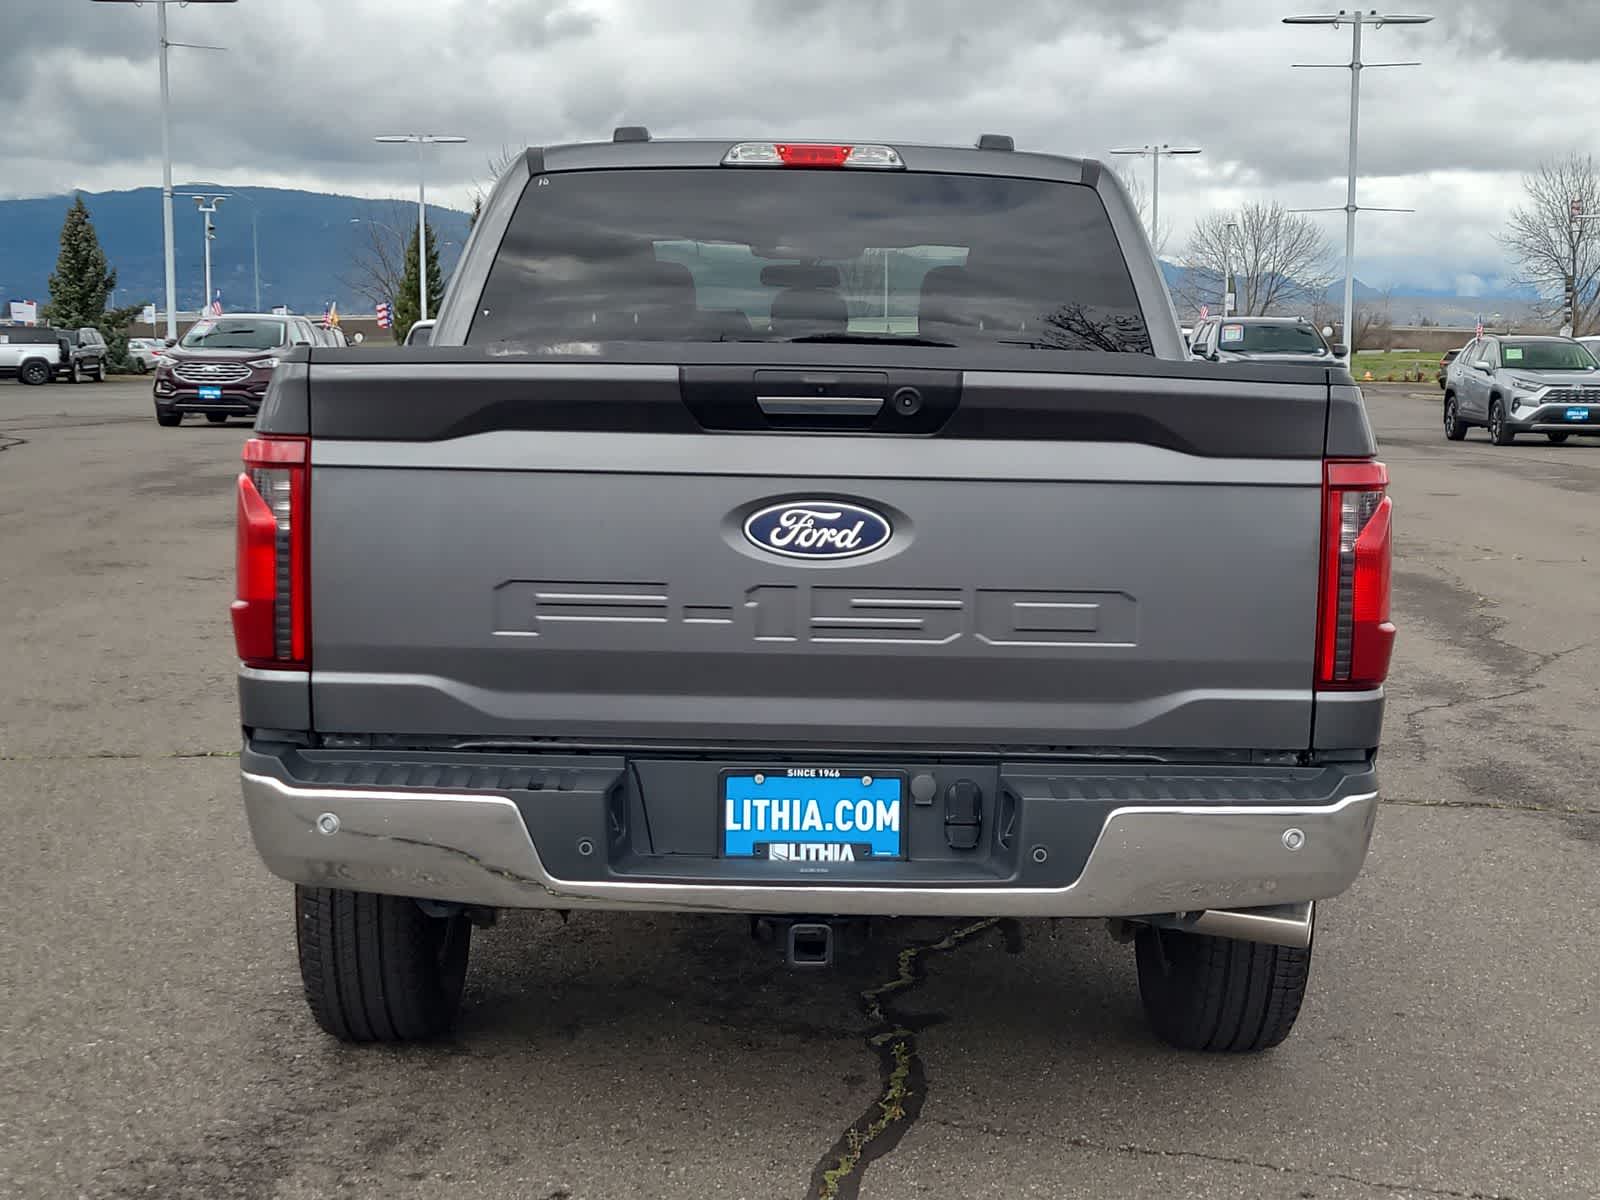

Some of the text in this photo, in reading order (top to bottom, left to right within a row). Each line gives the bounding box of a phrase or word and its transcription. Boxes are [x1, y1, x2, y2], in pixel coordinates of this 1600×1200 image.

[769, 509, 865, 549] Ford
[492, 579, 1138, 647] F-150
[787, 768, 841, 778] SINCE 1946
[725, 799, 900, 832] LITHIA.COM
[789, 843, 855, 862] LITHIA
